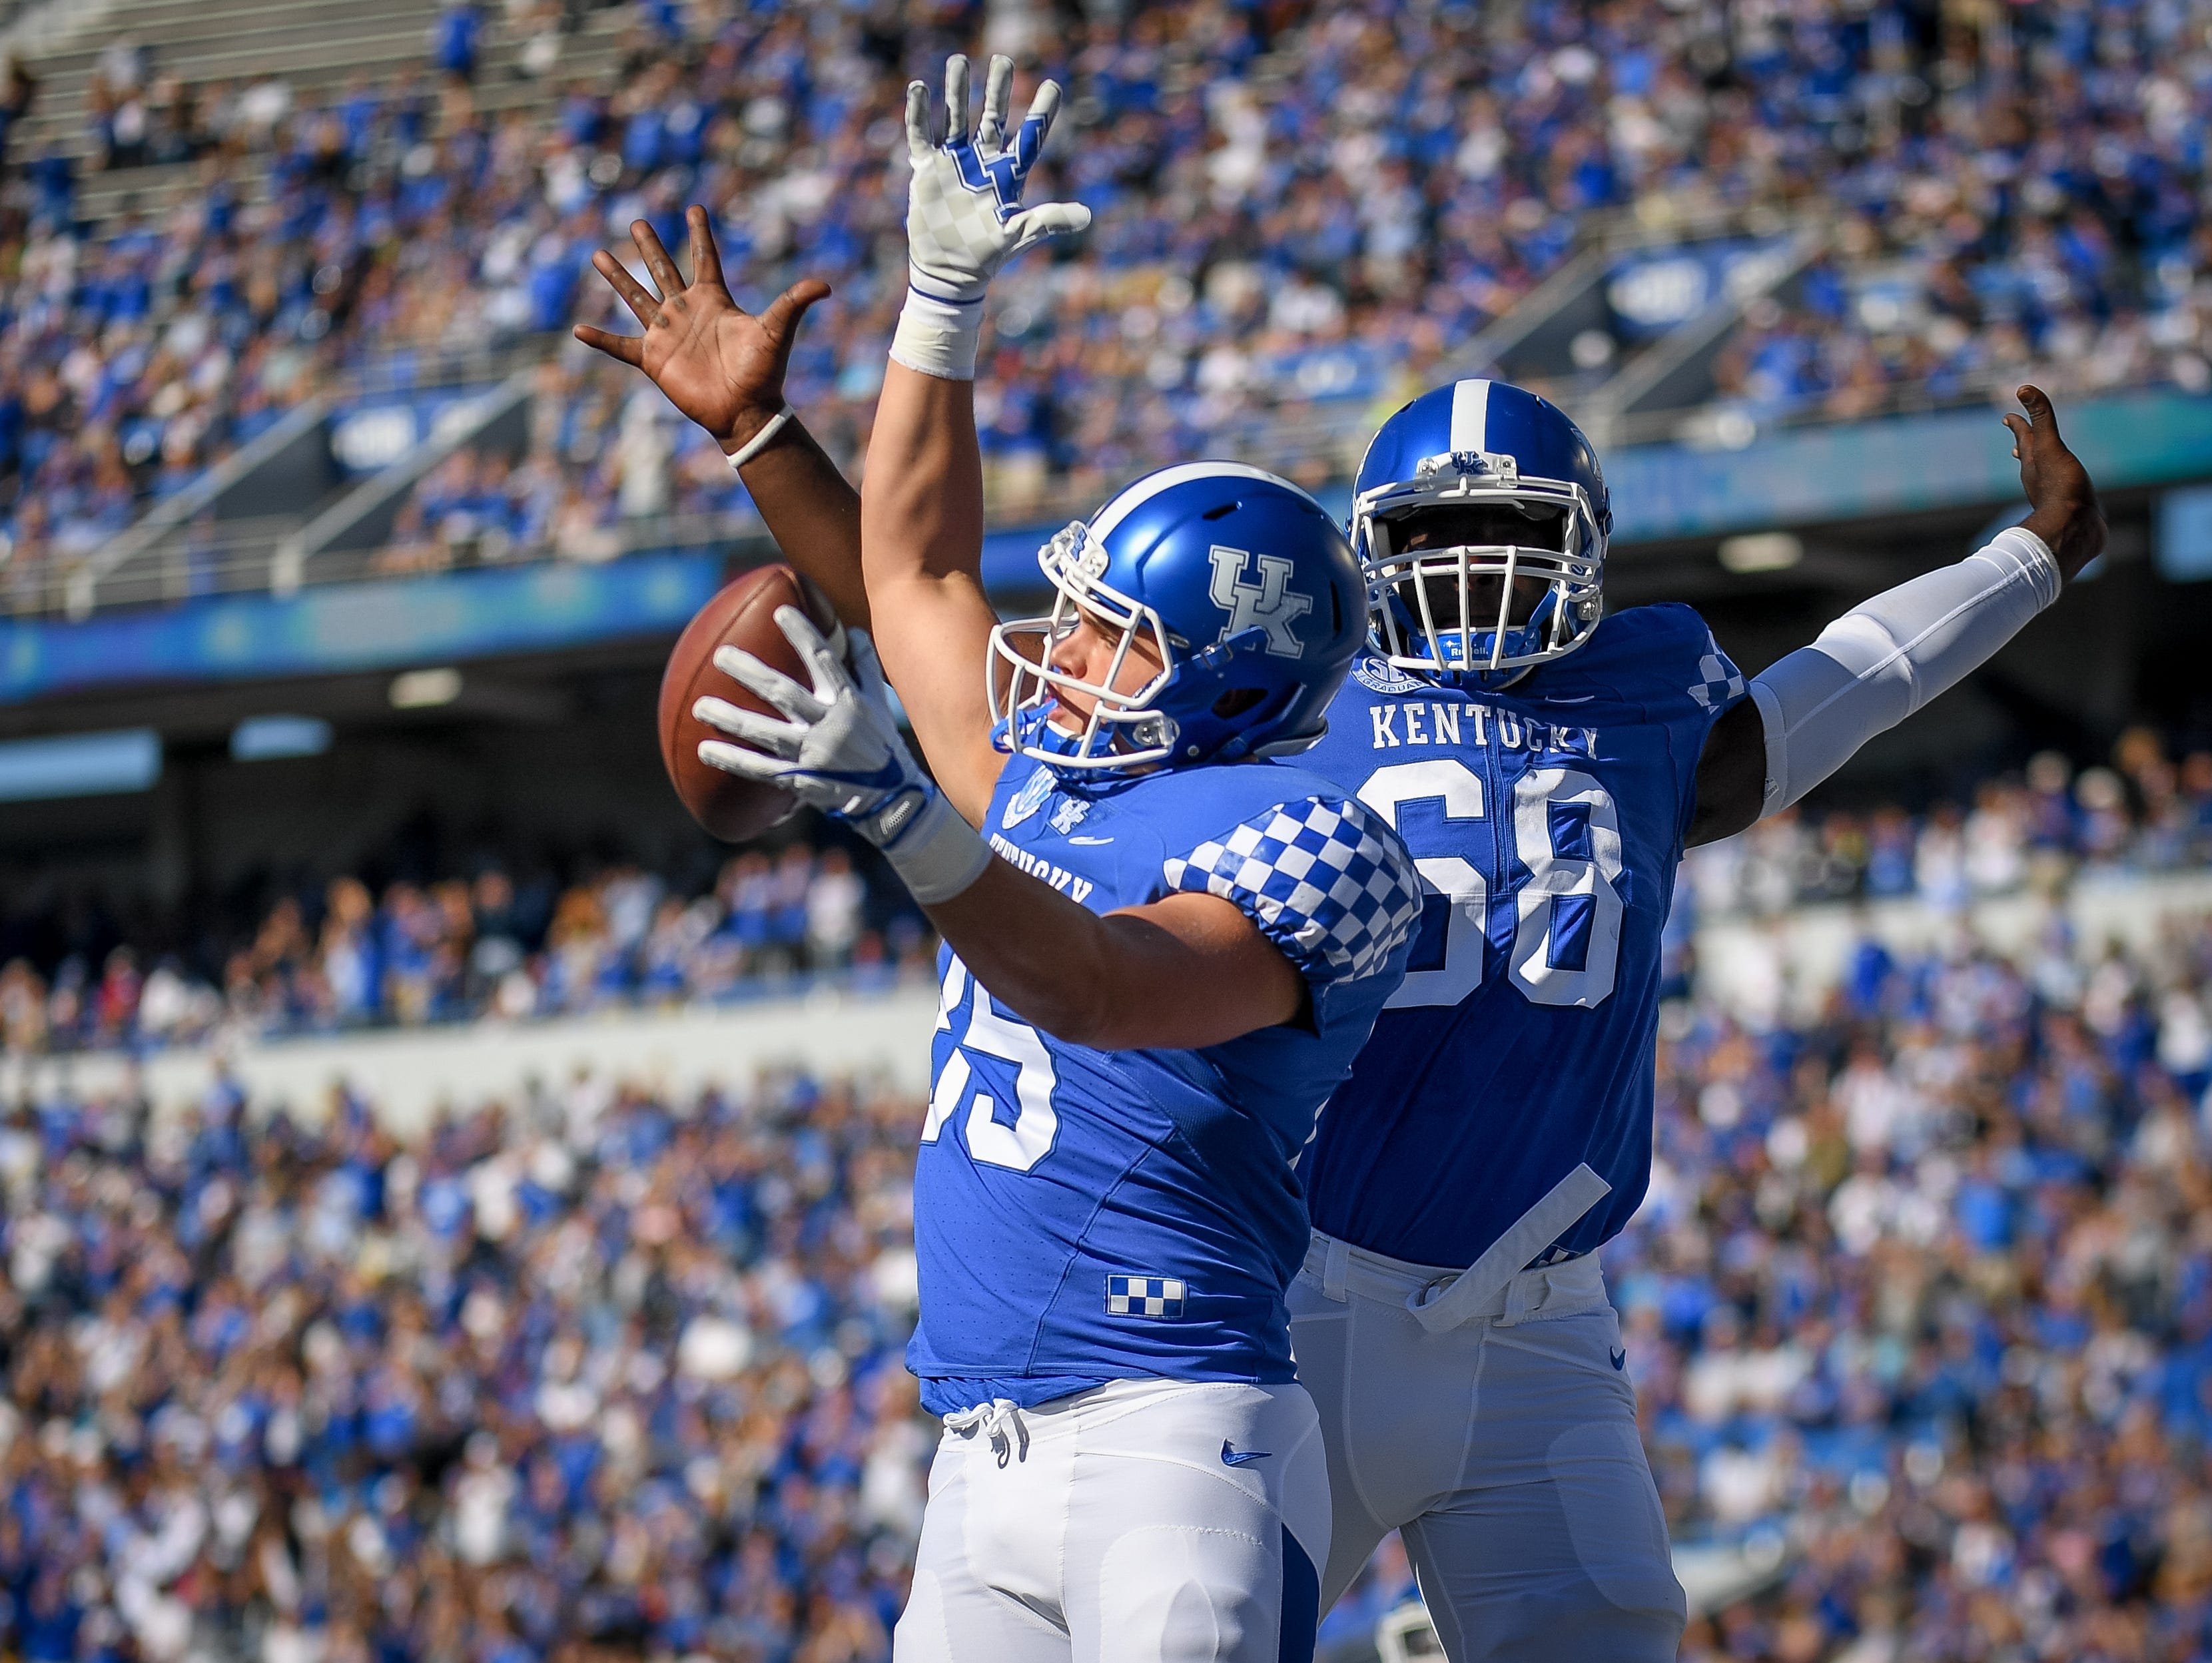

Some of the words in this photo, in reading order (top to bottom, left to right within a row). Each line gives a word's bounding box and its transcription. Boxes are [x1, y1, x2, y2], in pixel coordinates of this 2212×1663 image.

[1208, 544, 1313, 659] UK
[1369, 703, 1599, 760] KENTUCKY
[1356, 758, 1624, 1010] 68
